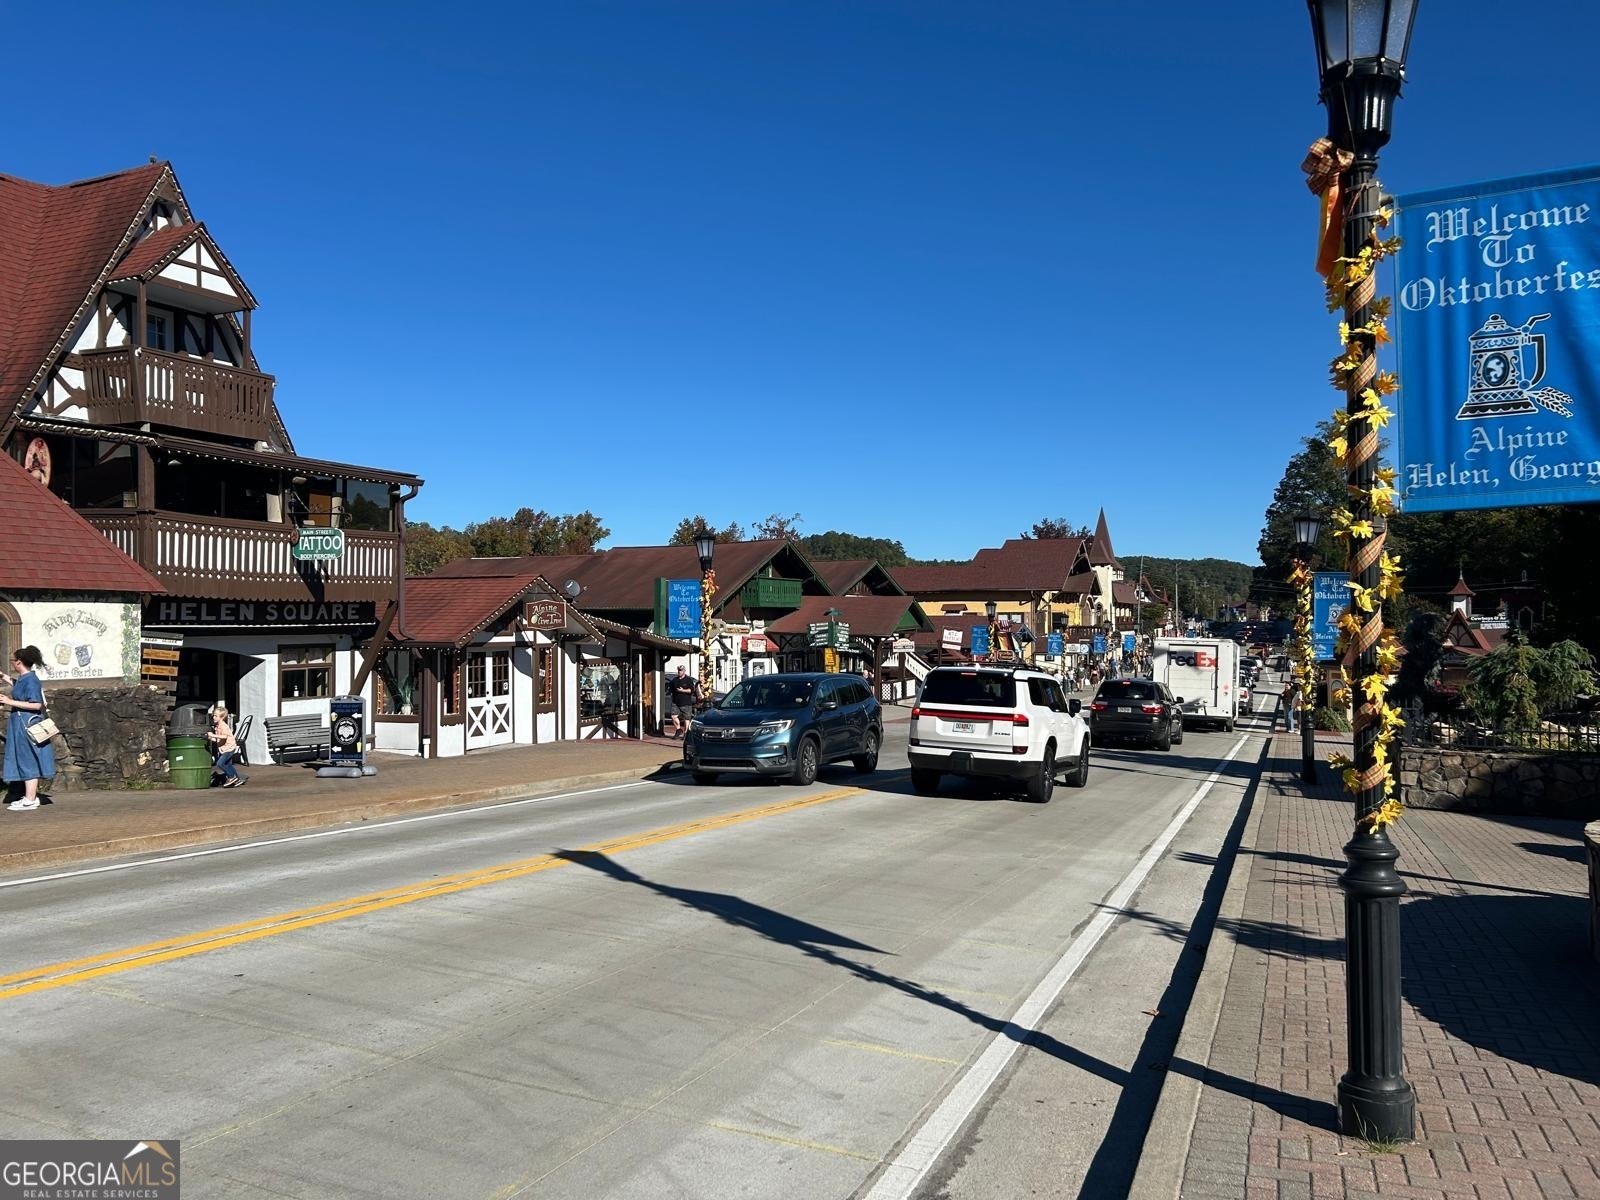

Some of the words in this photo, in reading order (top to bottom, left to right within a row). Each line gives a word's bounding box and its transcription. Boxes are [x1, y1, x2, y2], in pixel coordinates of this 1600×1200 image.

[1426, 203, 1590, 252] Welcome
[1478, 234, 1536, 268] To
[1464, 425, 1568, 461] Alpine
[1406, 462, 1499, 495] Helen,
[299, 535, 342, 550] TATTOO
[160, 602, 255, 621] HELEN
[265, 603, 361, 621] SQUARE
[1167, 651, 1217, 668] FedEx
